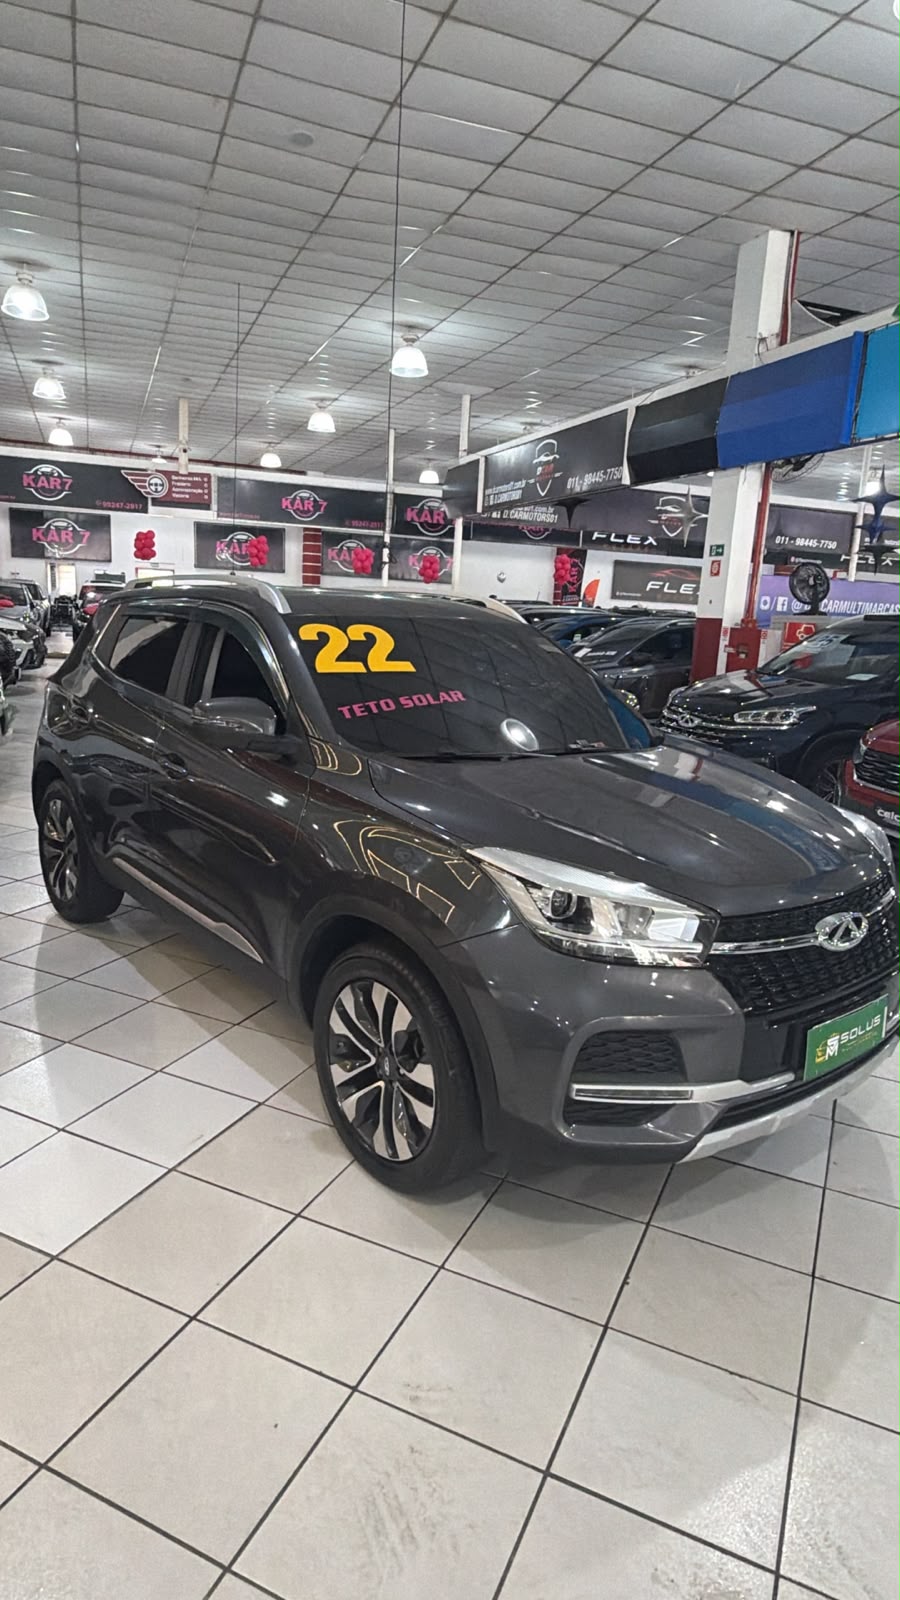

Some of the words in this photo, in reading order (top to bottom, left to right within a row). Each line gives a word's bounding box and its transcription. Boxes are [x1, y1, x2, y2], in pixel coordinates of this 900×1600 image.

[32, 528, 74, 543] KAR
[775, 535, 790, 544] 011
[795, 537, 838, 550] 98445-7750
[645, 580, 700, 595] FLE
[298, 623, 416, 674] 22
[337, 698, 396, 719] TETO
[398, 690, 466, 708] SOLAR
[840, 1014, 882, 1044] SOLUS
